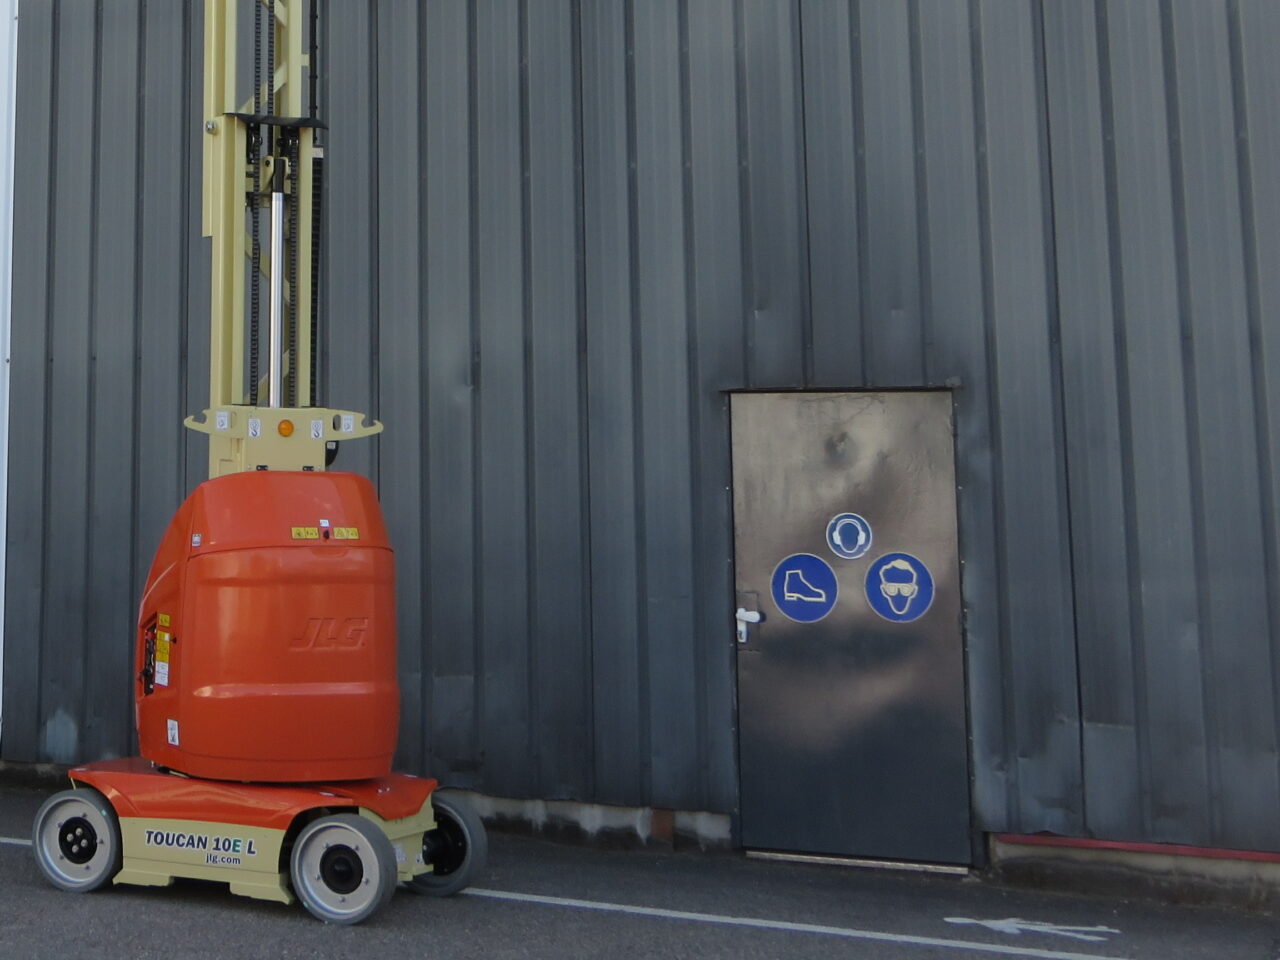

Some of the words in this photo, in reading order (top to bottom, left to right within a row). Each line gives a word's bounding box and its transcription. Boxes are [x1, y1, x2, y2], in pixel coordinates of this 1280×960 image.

[289, 617, 368, 651] JLG
[145, 830, 208, 850] TOUCAN
[212, 837, 242, 853] 10E
[247, 840, 256, 855] L
[206, 853, 241, 865] jlg.com
